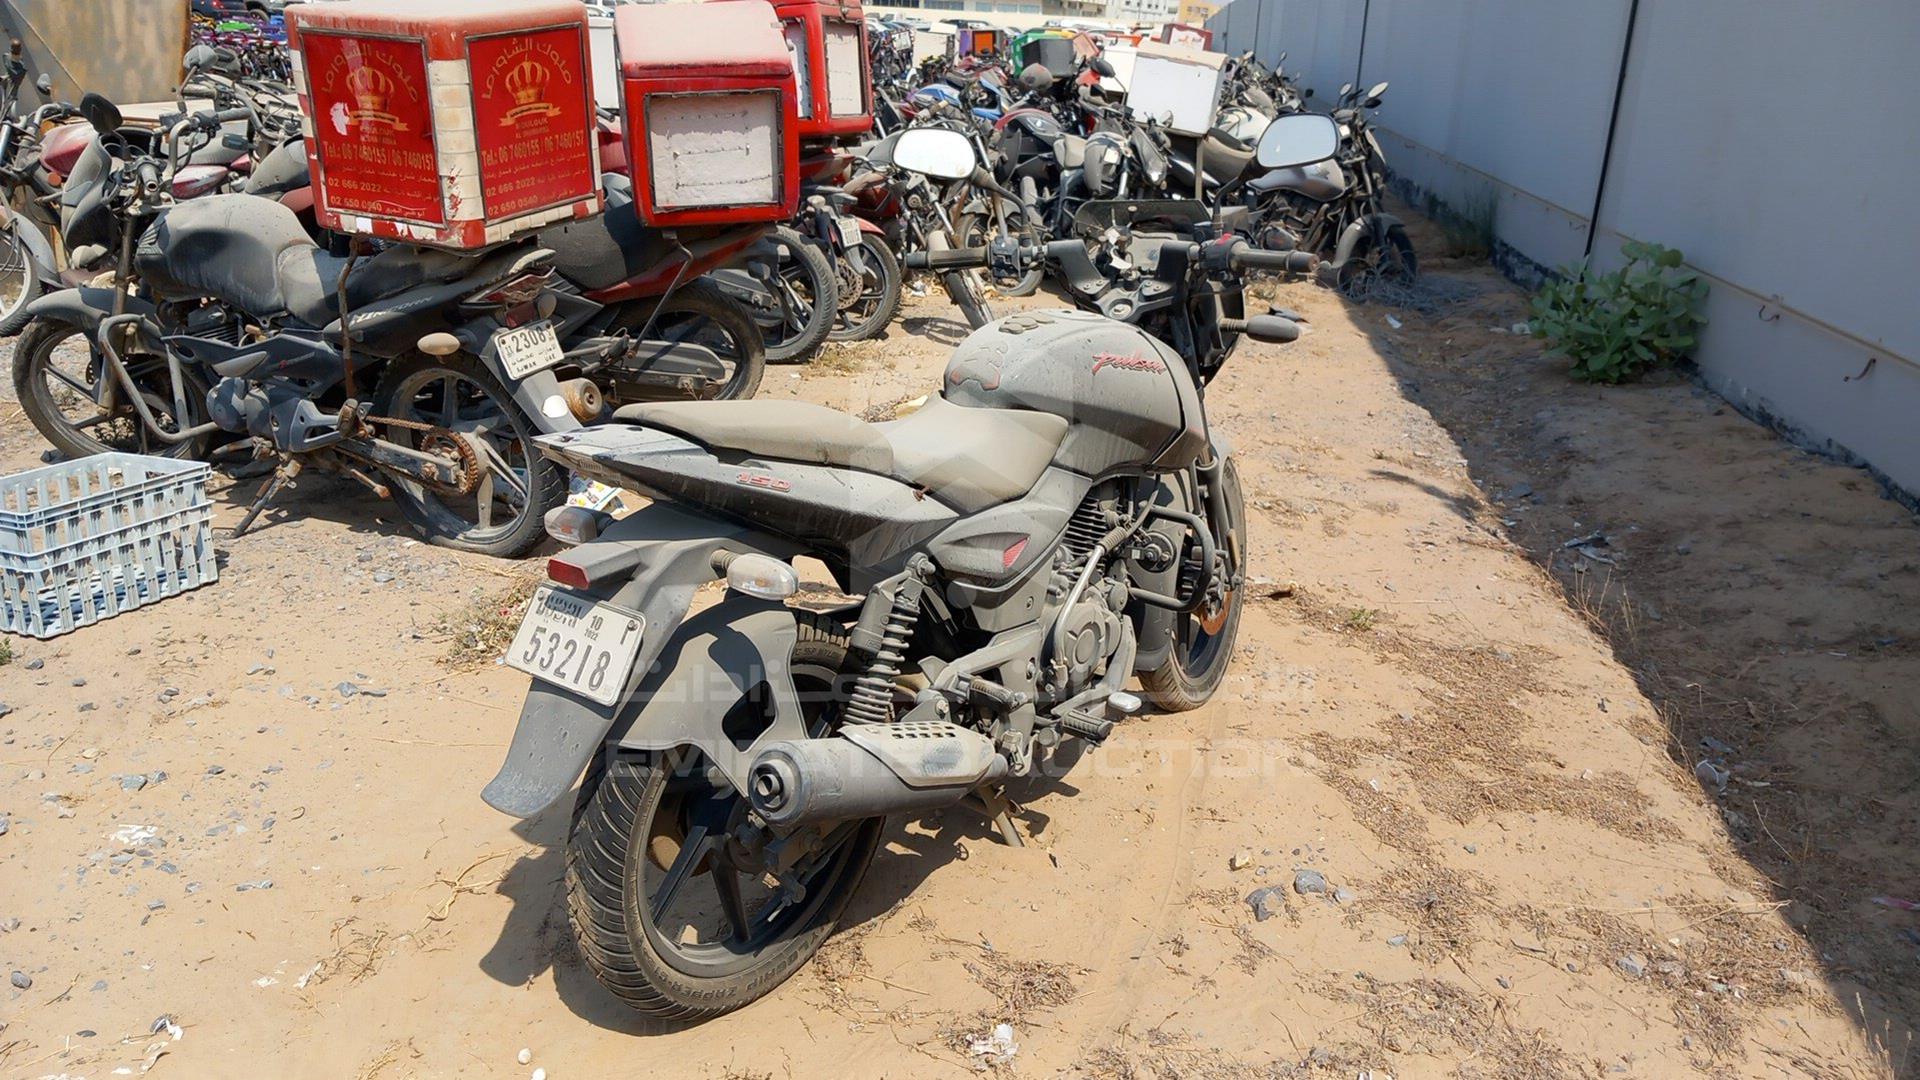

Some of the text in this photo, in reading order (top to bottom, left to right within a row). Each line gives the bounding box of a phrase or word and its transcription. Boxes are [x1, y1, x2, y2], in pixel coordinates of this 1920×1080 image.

[536, 42, 572, 85] ملوك
[328, 177, 340, 187] 02
[360, 181, 381, 193] 2022
[486, 186, 496, 197] 02
[515, 176, 536, 190] 2022
[330, 195, 341, 207] 02
[487, 205, 499, 216] 02
[510, 326, 546, 353] 2308
[736, 471, 791, 492] 150
[590, 614, 604, 631] 10
[523, 626, 611, 691] 53218
